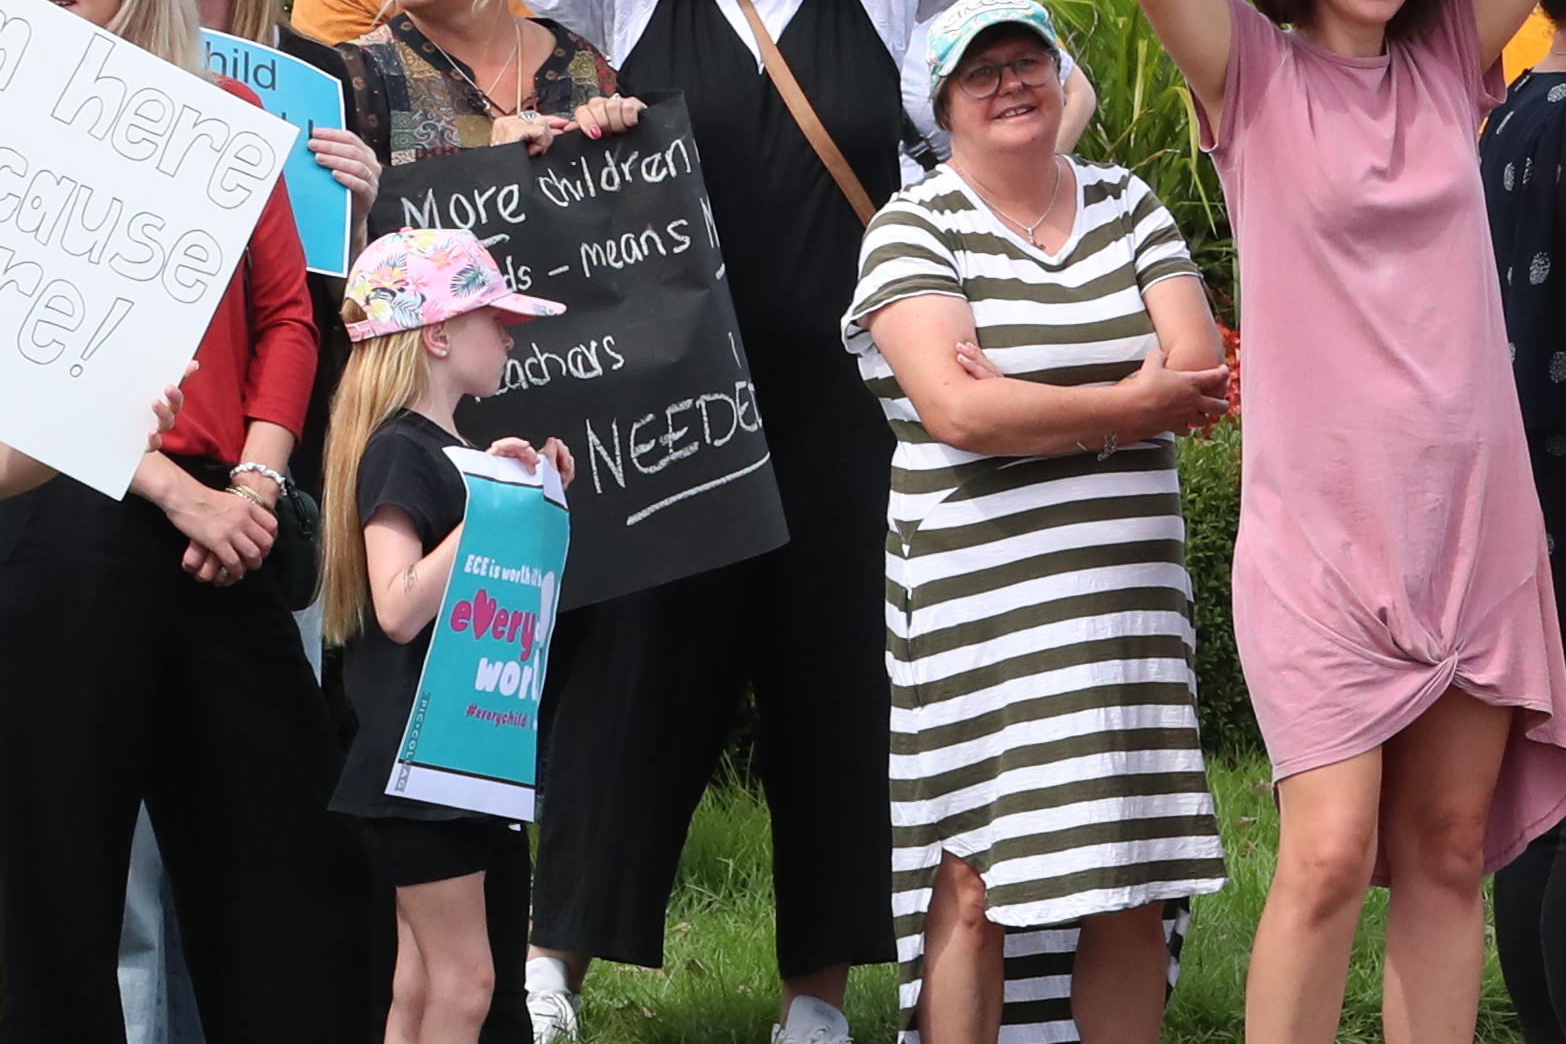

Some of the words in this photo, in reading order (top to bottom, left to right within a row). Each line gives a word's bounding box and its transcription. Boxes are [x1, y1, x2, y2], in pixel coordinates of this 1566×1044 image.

[205, 41, 277, 92] hild
[51, 32, 276, 210] here
[401, 183, 527, 230] More
[538, 138, 692, 208] children
[580, 217, 692, 278] means
[463, 554, 491, 576] ECE
[489, 558, 501, 579] is
